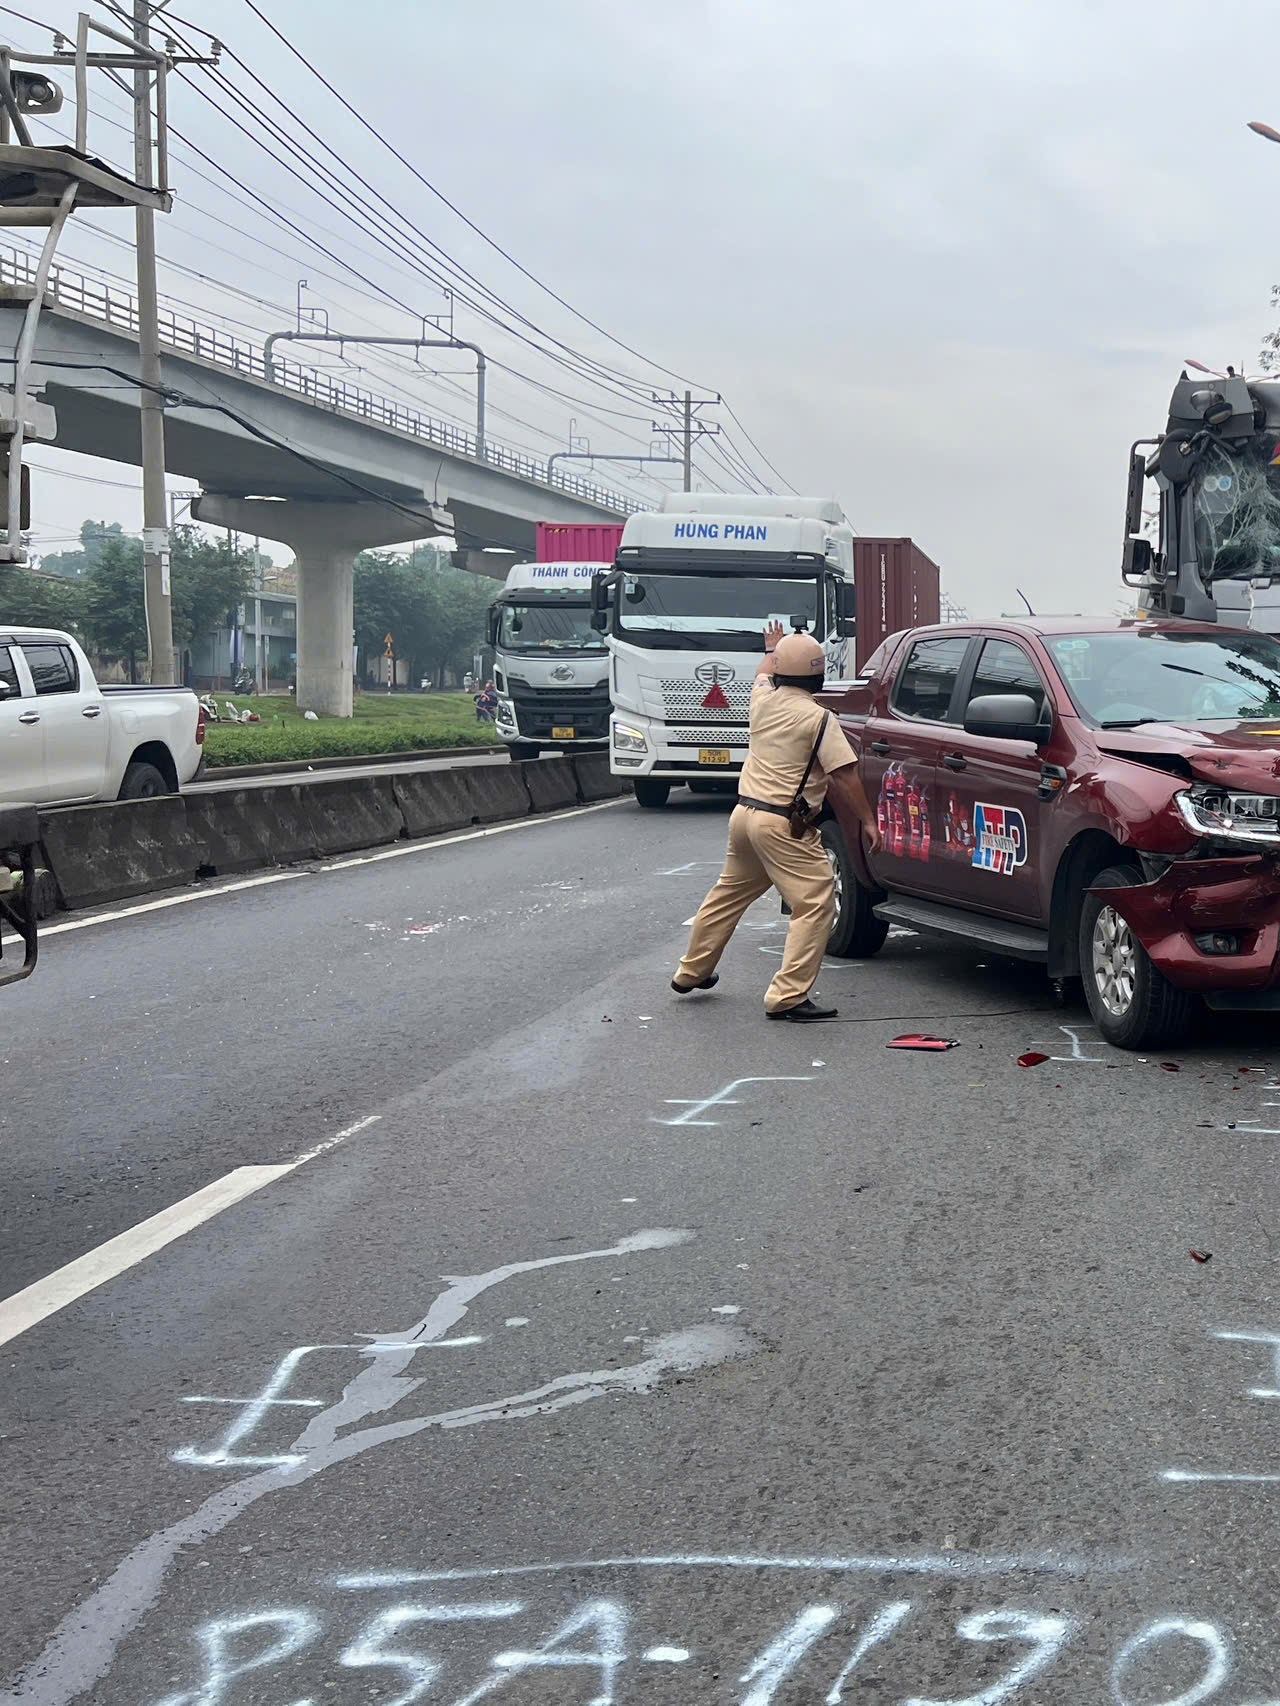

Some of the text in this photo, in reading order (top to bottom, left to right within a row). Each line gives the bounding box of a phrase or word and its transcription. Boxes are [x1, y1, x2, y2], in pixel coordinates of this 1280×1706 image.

[674, 519, 767, 541] HÙNG PHAN
[994, 835, 1015, 852] SAFETY
